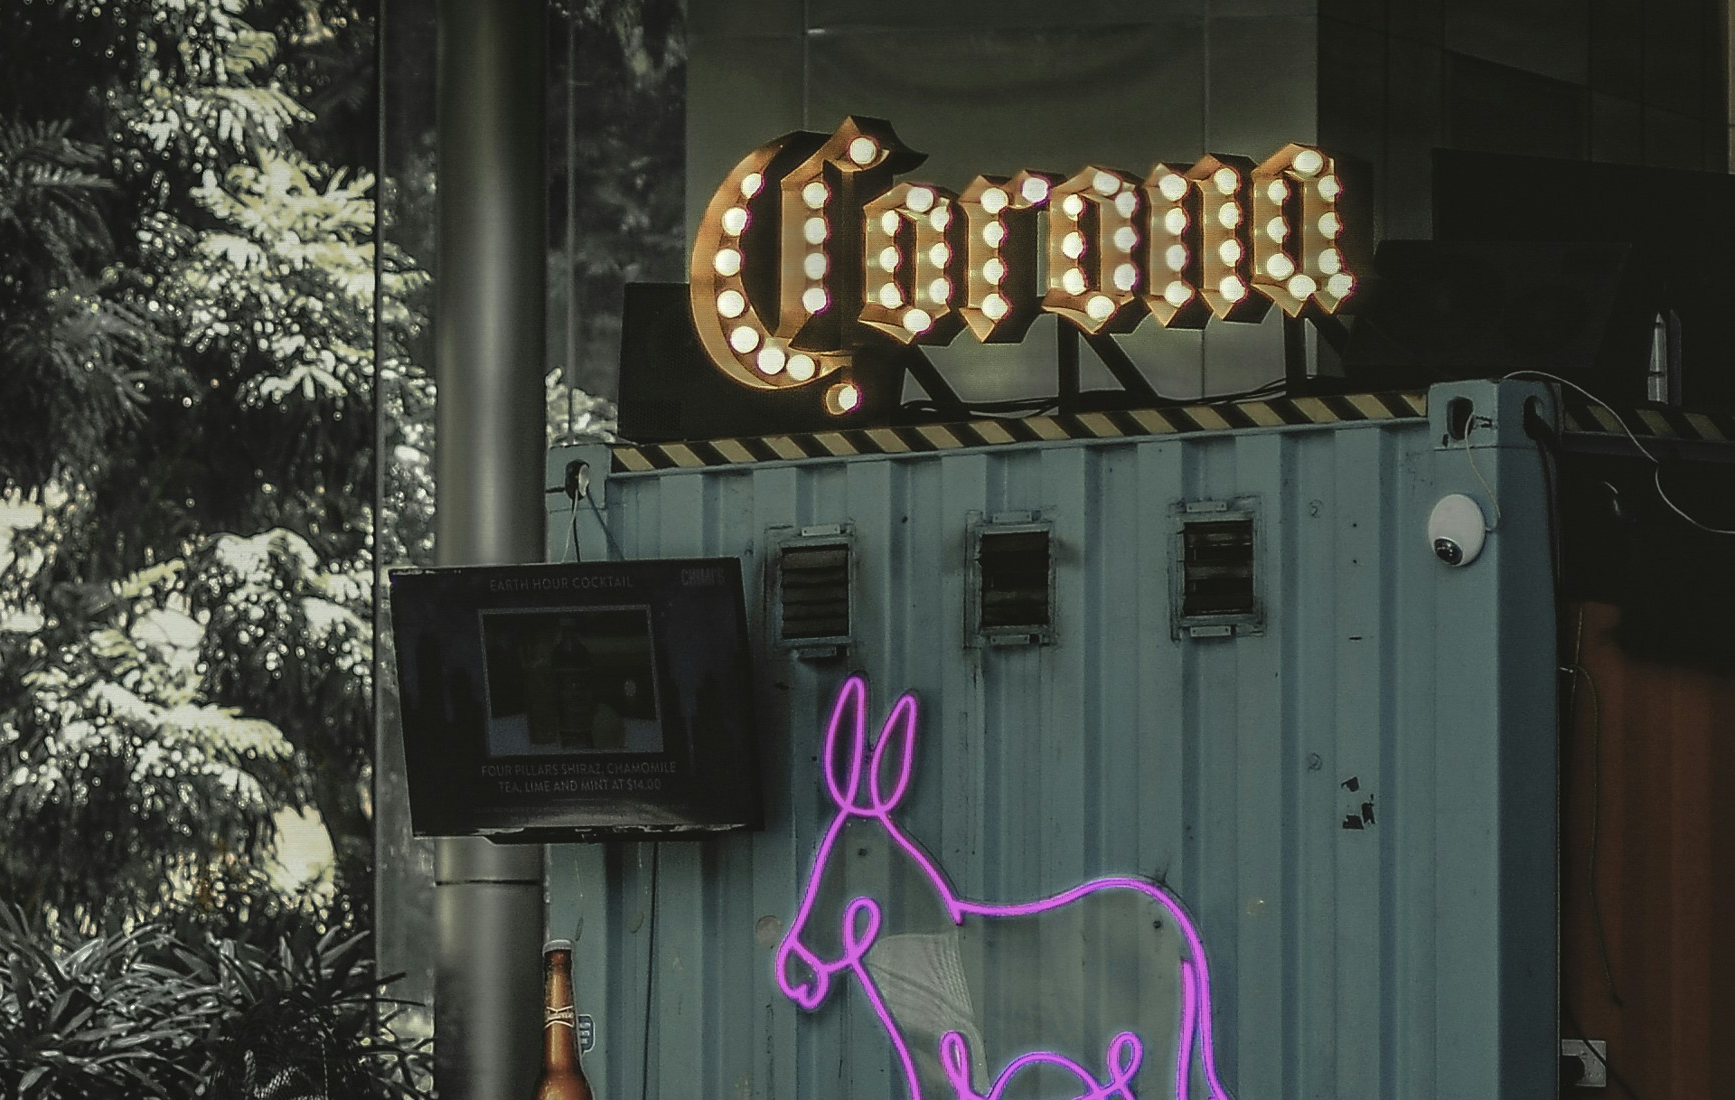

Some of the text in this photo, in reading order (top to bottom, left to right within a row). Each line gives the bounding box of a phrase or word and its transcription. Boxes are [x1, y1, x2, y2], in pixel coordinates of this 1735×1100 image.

[690, 115, 1357, 415] Corona
[489, 575, 634, 593] EARTH HOUR COCKTAIL
[481, 761, 677, 777] FOUR PILLARS SHIRAZ, CHAMOMILE
[525, 780, 550, 793] LIME
[553, 779, 578, 792] AND
[581, 778, 608, 791] MINT
[612, 779, 624, 791] AT
[626, 778, 662, 791] $14.00
